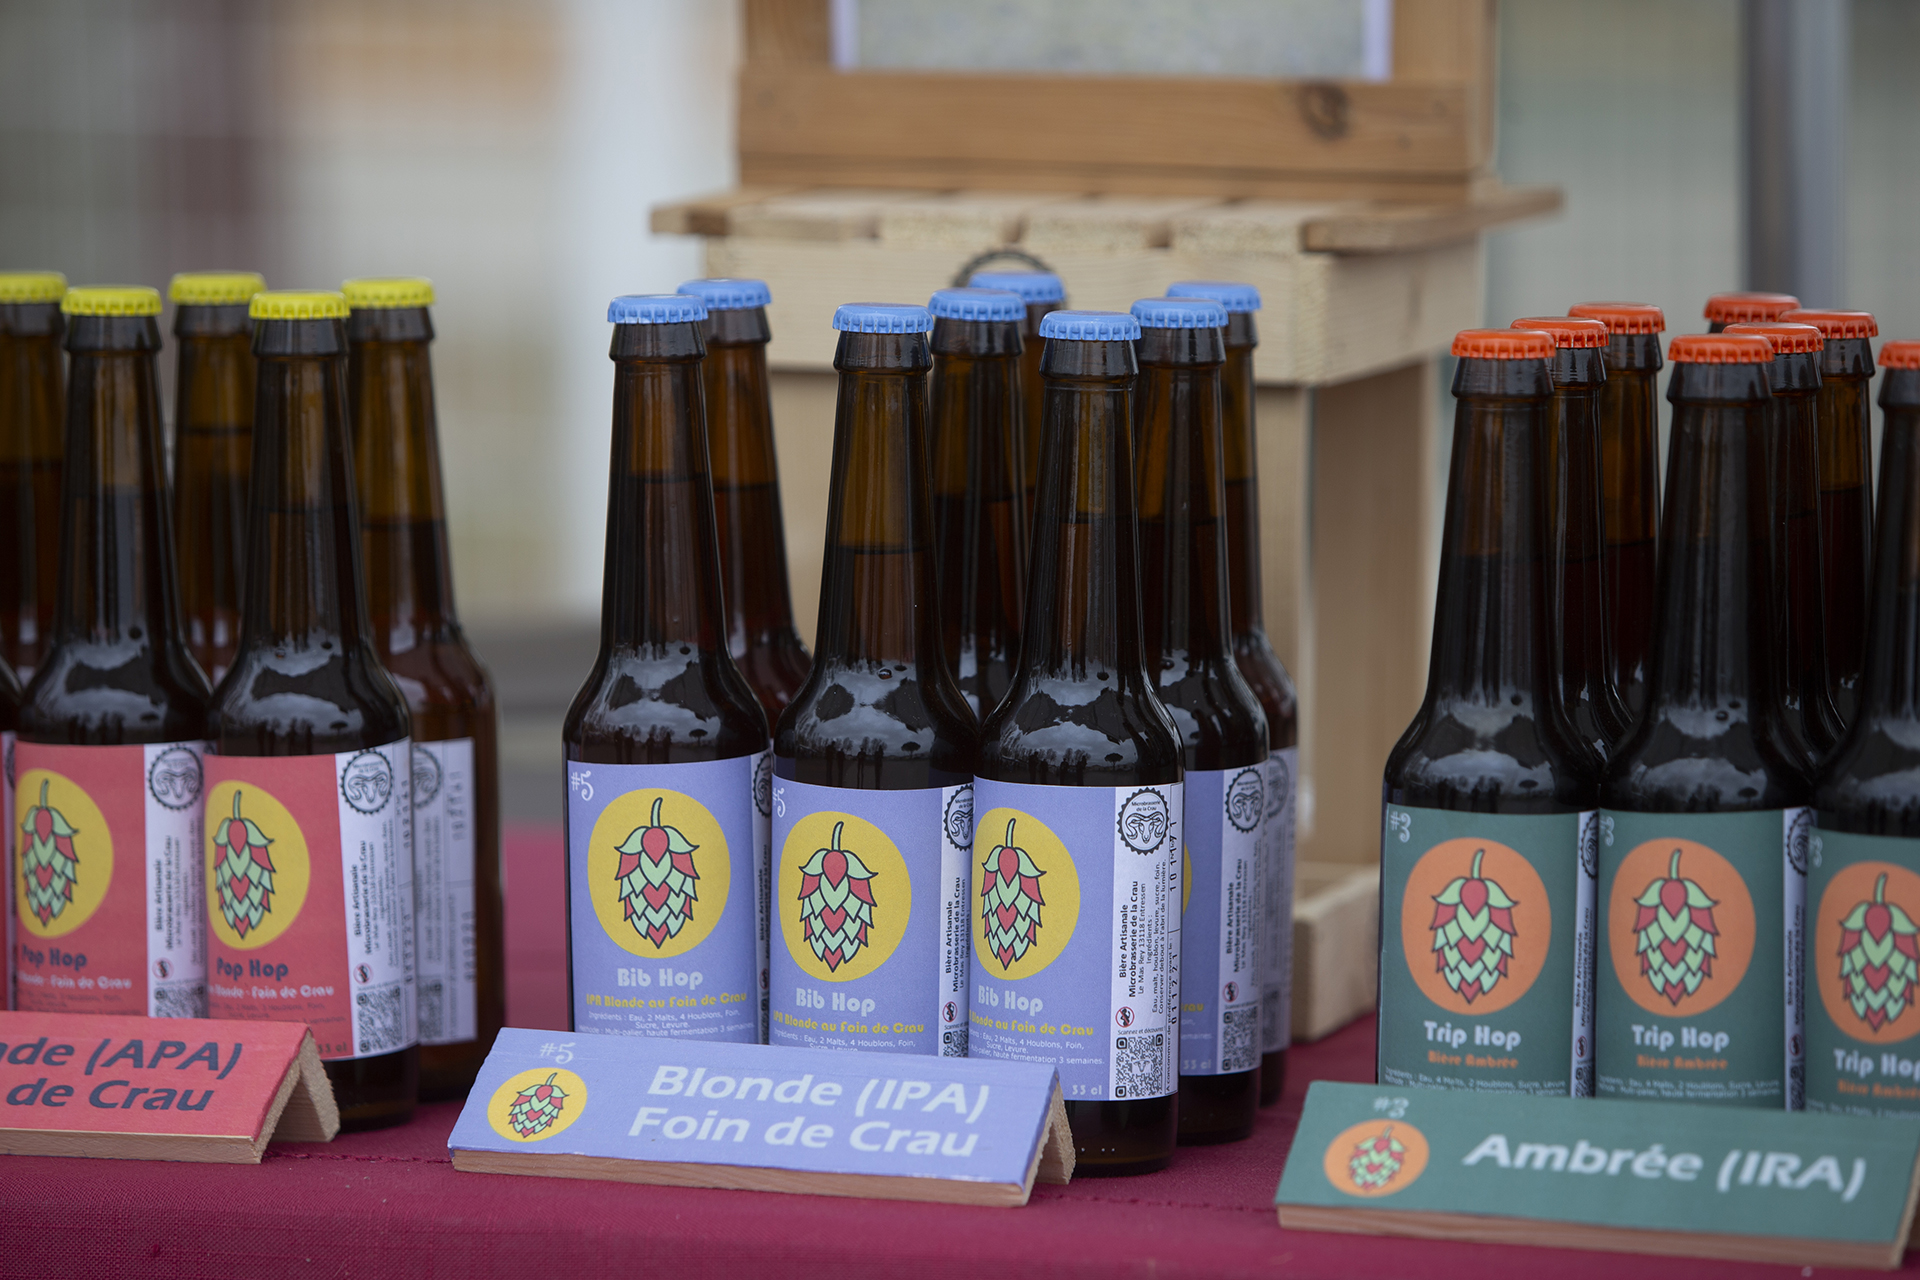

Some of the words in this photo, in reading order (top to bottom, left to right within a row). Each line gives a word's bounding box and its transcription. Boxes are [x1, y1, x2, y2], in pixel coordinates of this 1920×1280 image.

[571, 770, 594, 802] #5
[1390, 811, 1411, 843] #3
[954, 900, 960, 908] la
[1160, 894, 1166, 902] la
[954, 911, 960, 922] de
[1130, 904, 1138, 912] la
[1160, 904, 1166, 913] de
[1120, 905, 1129, 951] Artisanale
[1130, 916, 1137, 927] de
[49, 947, 88, 972] Hop
[1119, 954, 1127, 978] Bière
[1128, 930, 1138, 998] Microbrasserie
[217, 957, 243, 981] Pop
[249, 959, 289, 982] Hop
[78, 976, 95, 990] de
[97, 975, 132, 990] Crau
[617, 968, 652, 987] Bib
[659, 968, 704, 991] Hop
[252, 985, 277, 999] Foin
[280, 986, 297, 999] de
[300, 985, 334, 998] Crau
[1138, 986, 1144, 994] Le
[586, 993, 602, 1006] IPA
[604, 996, 645, 1009] Blonde
[648, 1000, 666, 1009] au
[669, 996, 698, 1009] Foin
[701, 995, 718, 1006] de
[720, 993, 748, 1004] Crau
[796, 988, 825, 1010] Bib
[832, 992, 876, 1018] Hop
[978, 985, 1000, 1007] Bib
[1004, 991, 1044, 1017] Hop
[629, 1014, 646, 1023] Eau,
[655, 1014, 676, 1022] Malts,
[687, 1011, 723, 1021] Houblons,
[635, 1022, 660, 1030] Sucre,
[662, 1021, 691, 1029] Levure.
[785, 1014, 819, 1031] Blonde
[821, 1021, 837, 1032] au
[840, 1021, 868, 1034] Foin
[872, 1023, 890, 1034] de
[893, 1022, 925, 1034] Crau
[646, 1027, 669, 1037] haute
[670, 1025, 719, 1037] fermentation
[720, 1025, 726, 1033] 3
[996, 1020, 1009, 1031] au
[1011, 1020, 1036, 1034] Foin
[1040, 1023, 1057, 1035] de
[1061, 1024, 1095, 1036] Crau
[1424, 1020, 1468, 1049] Trip
[1475, 1025, 1522, 1052] Hop
[804, 1035, 819, 1044] Eau,
[826, 1038, 849, 1047] Malts,
[857, 1040, 896, 1049] Houblons,
[898, 1040, 917, 1048] Foin,
[1000, 1035, 1018, 1046] Malts,
[1026, 1040, 1063, 1050] Houblons,
[1065, 1042, 1085, 1050] Foin,
[1631, 1024, 1675, 1052] Trip
[1681, 1027, 1730, 1053] Hop
[540, 1042, 576, 1065] #5
[986, 1041, 1003, 1052] Sucre,
[1005, 1044, 1029, 1054] Levure.
[84, 1039, 243, 1080] (APA)
[993, 1050, 1010, 1060] haute
[1011, 1053, 1057, 1064] fermentation
[1066, 1057, 1106, 1065] semaines.
[1183, 1060, 1197, 1070] 33
[1201, 1060, 1212, 1070] cl
[1428, 1051, 1462, 1067] Bière
[1465, 1053, 1519, 1069] Ambrée
[1674, 1056, 1728, 1070] Ambrée
[1834, 1048, 1875, 1078] Trip
[6, 1078, 75, 1107] de
[88, 1080, 215, 1111] Crau
[647, 1065, 842, 1106] Blonde
[856, 1078, 989, 1125] (IPA)
[1072, 1085, 1087, 1096] 33
[1090, 1085, 1103, 1096] cl
[629, 1105, 753, 1142] Foin
[764, 1112, 838, 1148] de
[850, 1121, 978, 1157] Crau
[1462, 1134, 1703, 1181] Ambrée
[1717, 1149, 1866, 1202] (IRA)
